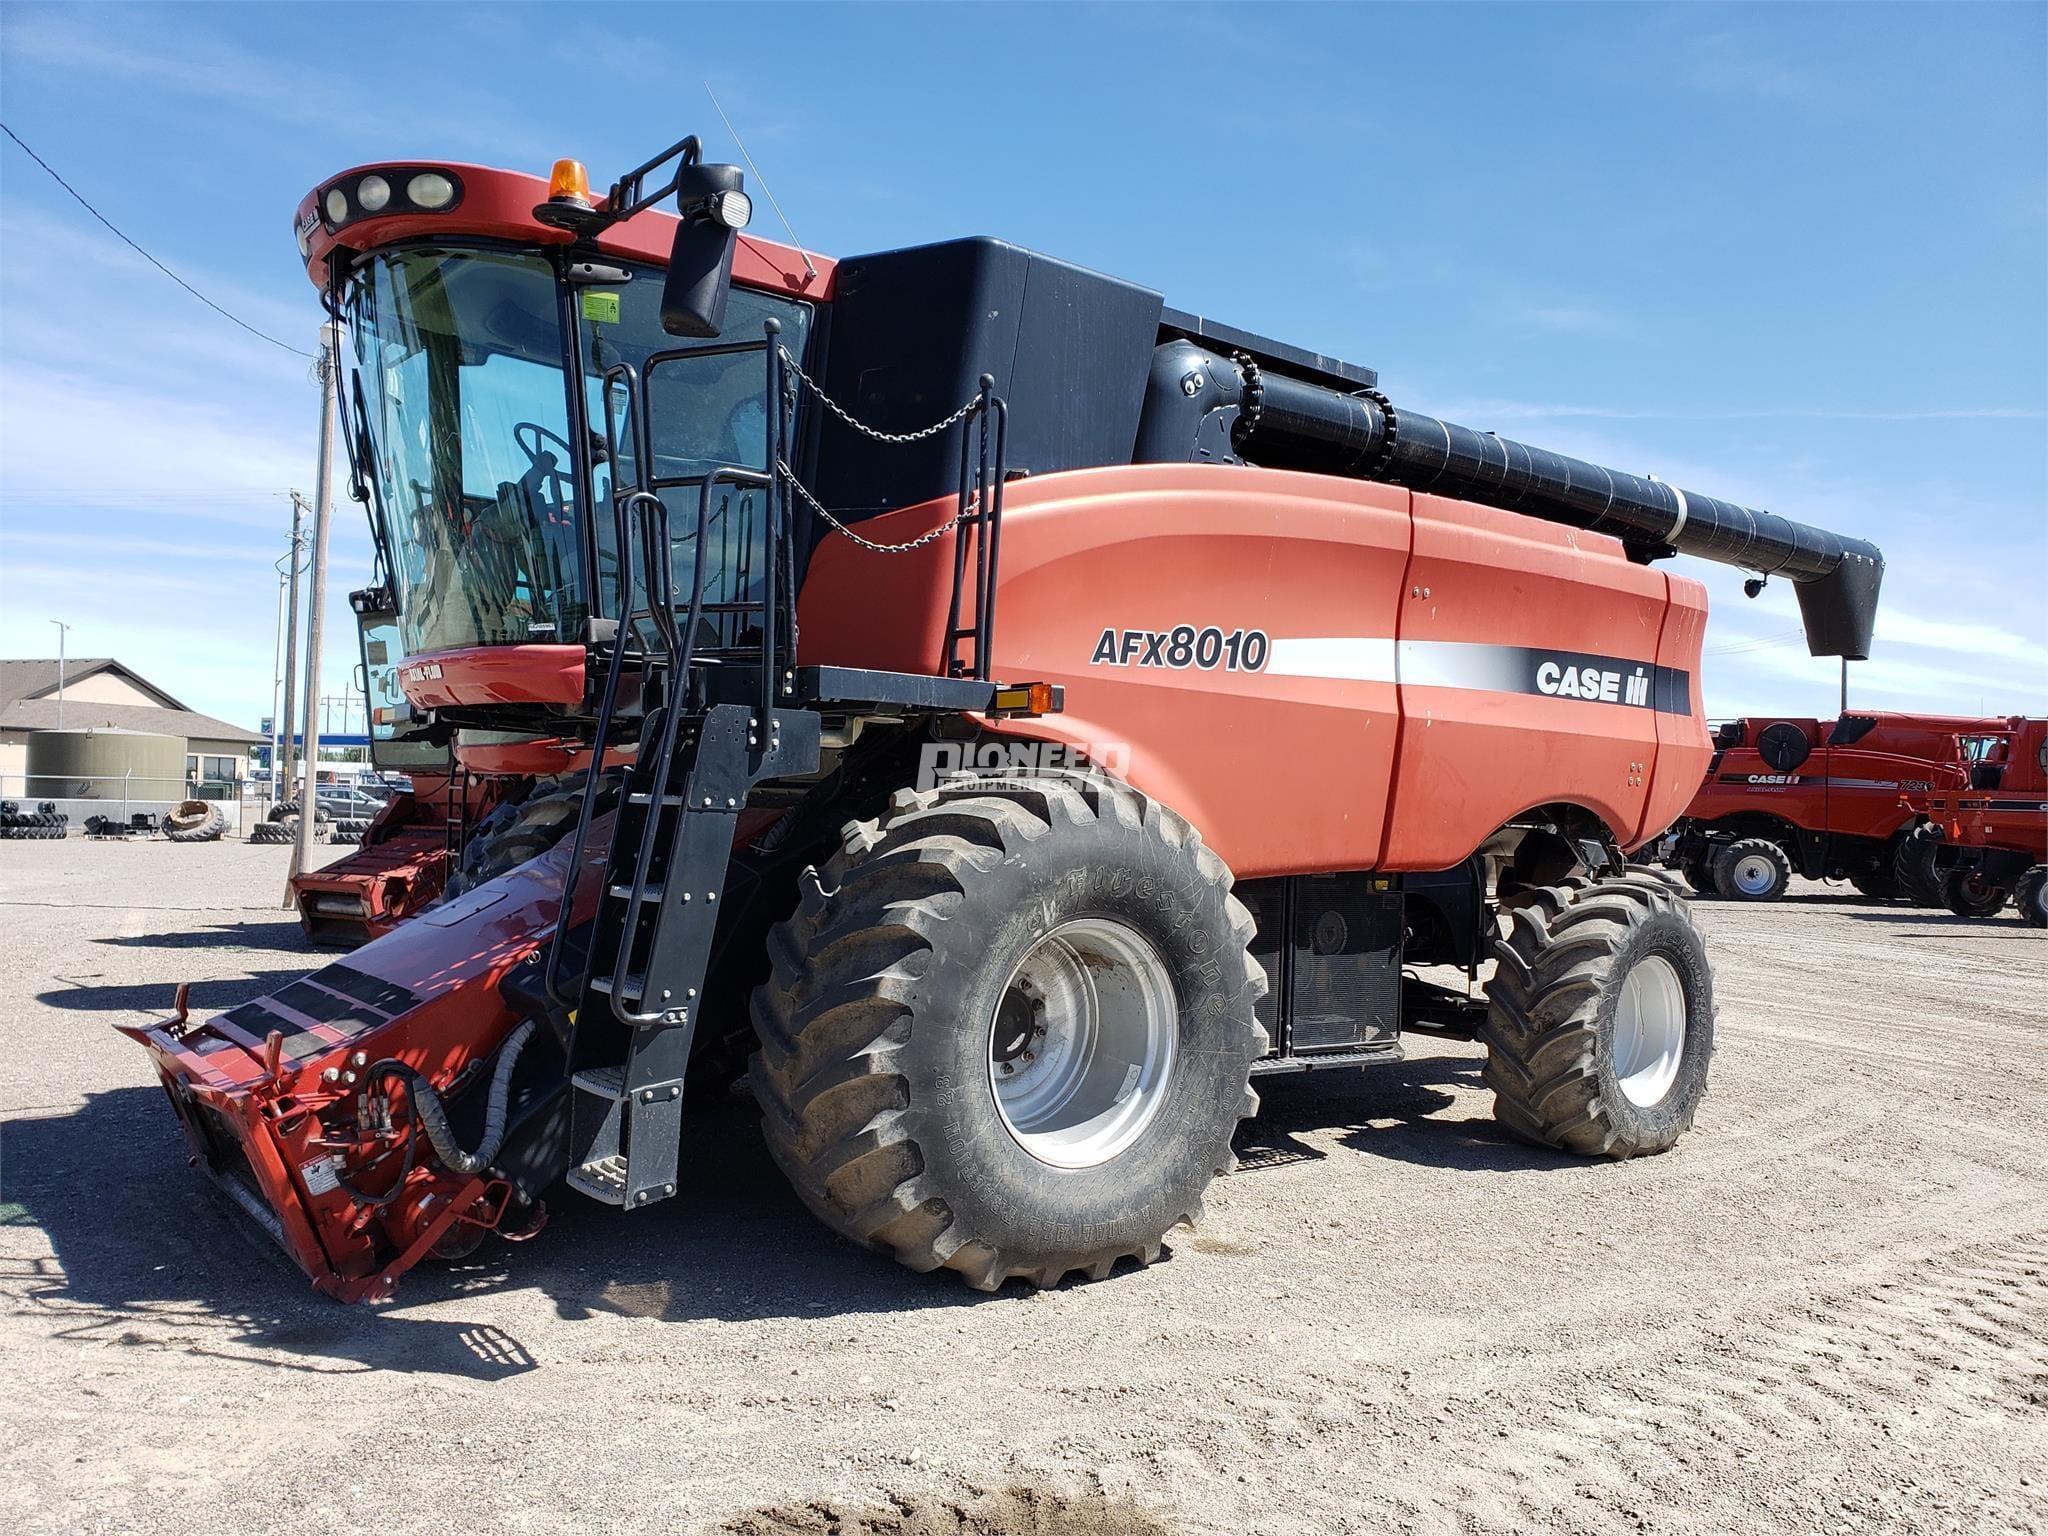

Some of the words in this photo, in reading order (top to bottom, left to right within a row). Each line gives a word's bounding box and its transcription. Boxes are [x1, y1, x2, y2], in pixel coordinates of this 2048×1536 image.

[1089, 624, 1270, 673] AFX8010
[1536, 661, 1621, 702] CASE
[1747, 774, 1786, 784] CASE
[1065, 865, 1227, 1017] Firestone
